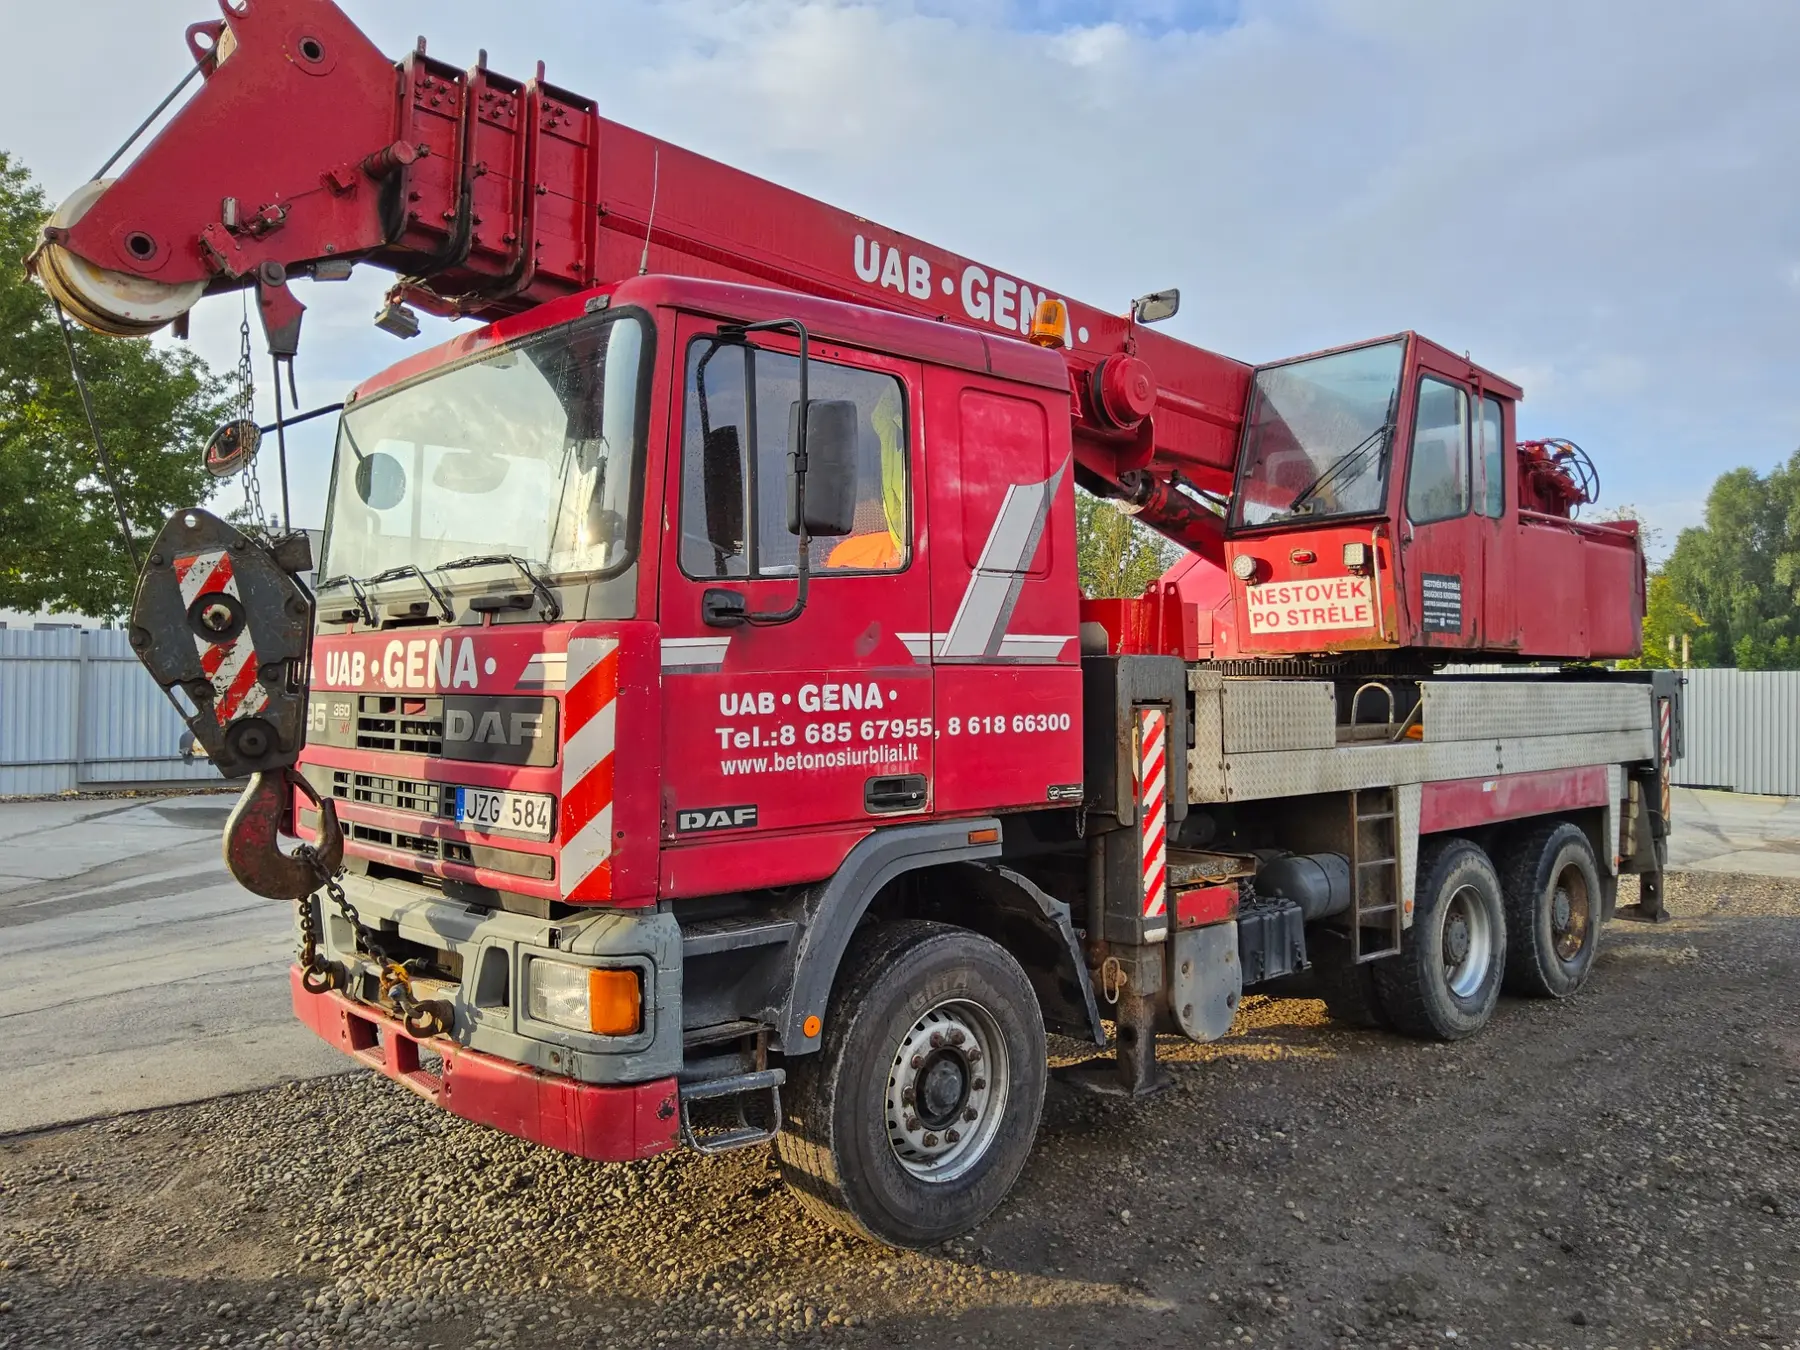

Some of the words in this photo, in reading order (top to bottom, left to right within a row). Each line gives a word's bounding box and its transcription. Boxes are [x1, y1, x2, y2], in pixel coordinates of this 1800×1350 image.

[854, 234, 931, 300] UAB
[1250, 580, 1366, 605] NESTOVĖK
[1253, 611, 1280, 628] PO
[1287, 603, 1368, 626] STRĖLE
[325, 651, 365, 686] UAB
[383, 636, 478, 688] GENA
[333, 702, 351, 717] 360
[720, 692, 775, 716] UAB
[798, 683, 883, 713] GENA
[445, 709, 543, 745] DAF
[805, 722, 852, 744] 685
[860, 717, 941, 740] 67955,
[948, 716, 961, 736] 8
[968, 715, 1006, 735] 618
[1012, 713, 1071, 733] 66300
[721, 743, 919, 776] www.betonosiurbliai.lt
[466, 793, 500, 823] JZG
[512, 798, 547, 830] 584
[680, 808, 756, 830] DAF
